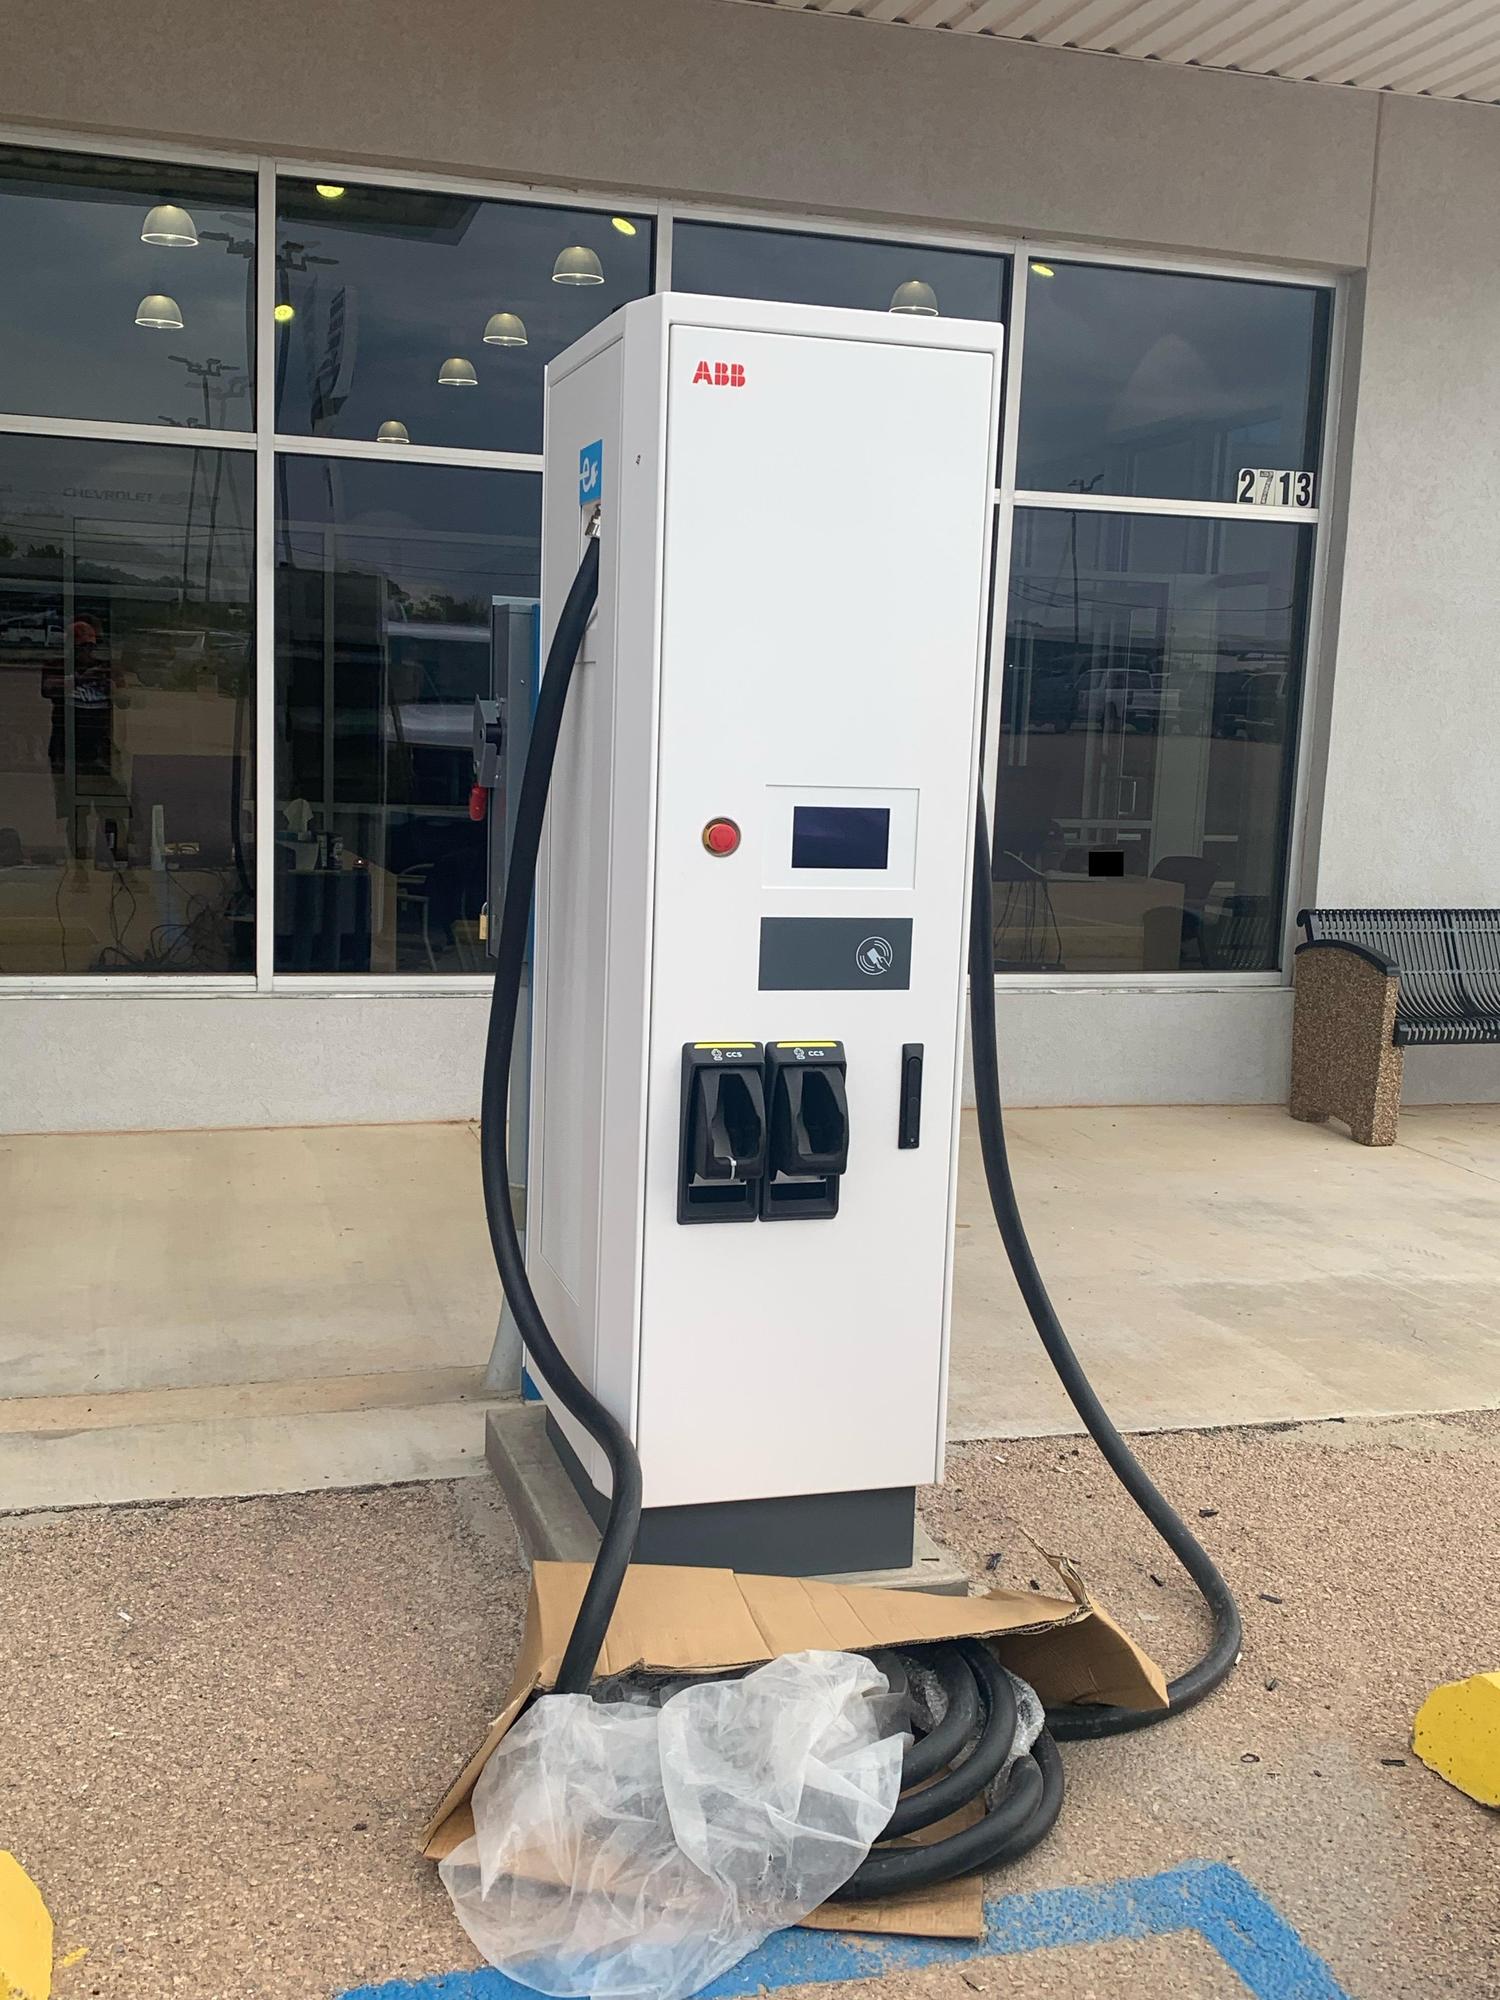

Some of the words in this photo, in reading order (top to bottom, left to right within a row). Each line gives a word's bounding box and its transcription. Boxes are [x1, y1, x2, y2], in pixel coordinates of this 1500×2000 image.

[692, 360, 746, 388] ABB
[63, 487, 152, 502] CHEVROLET
[1238, 469, 1311, 506] 2713
